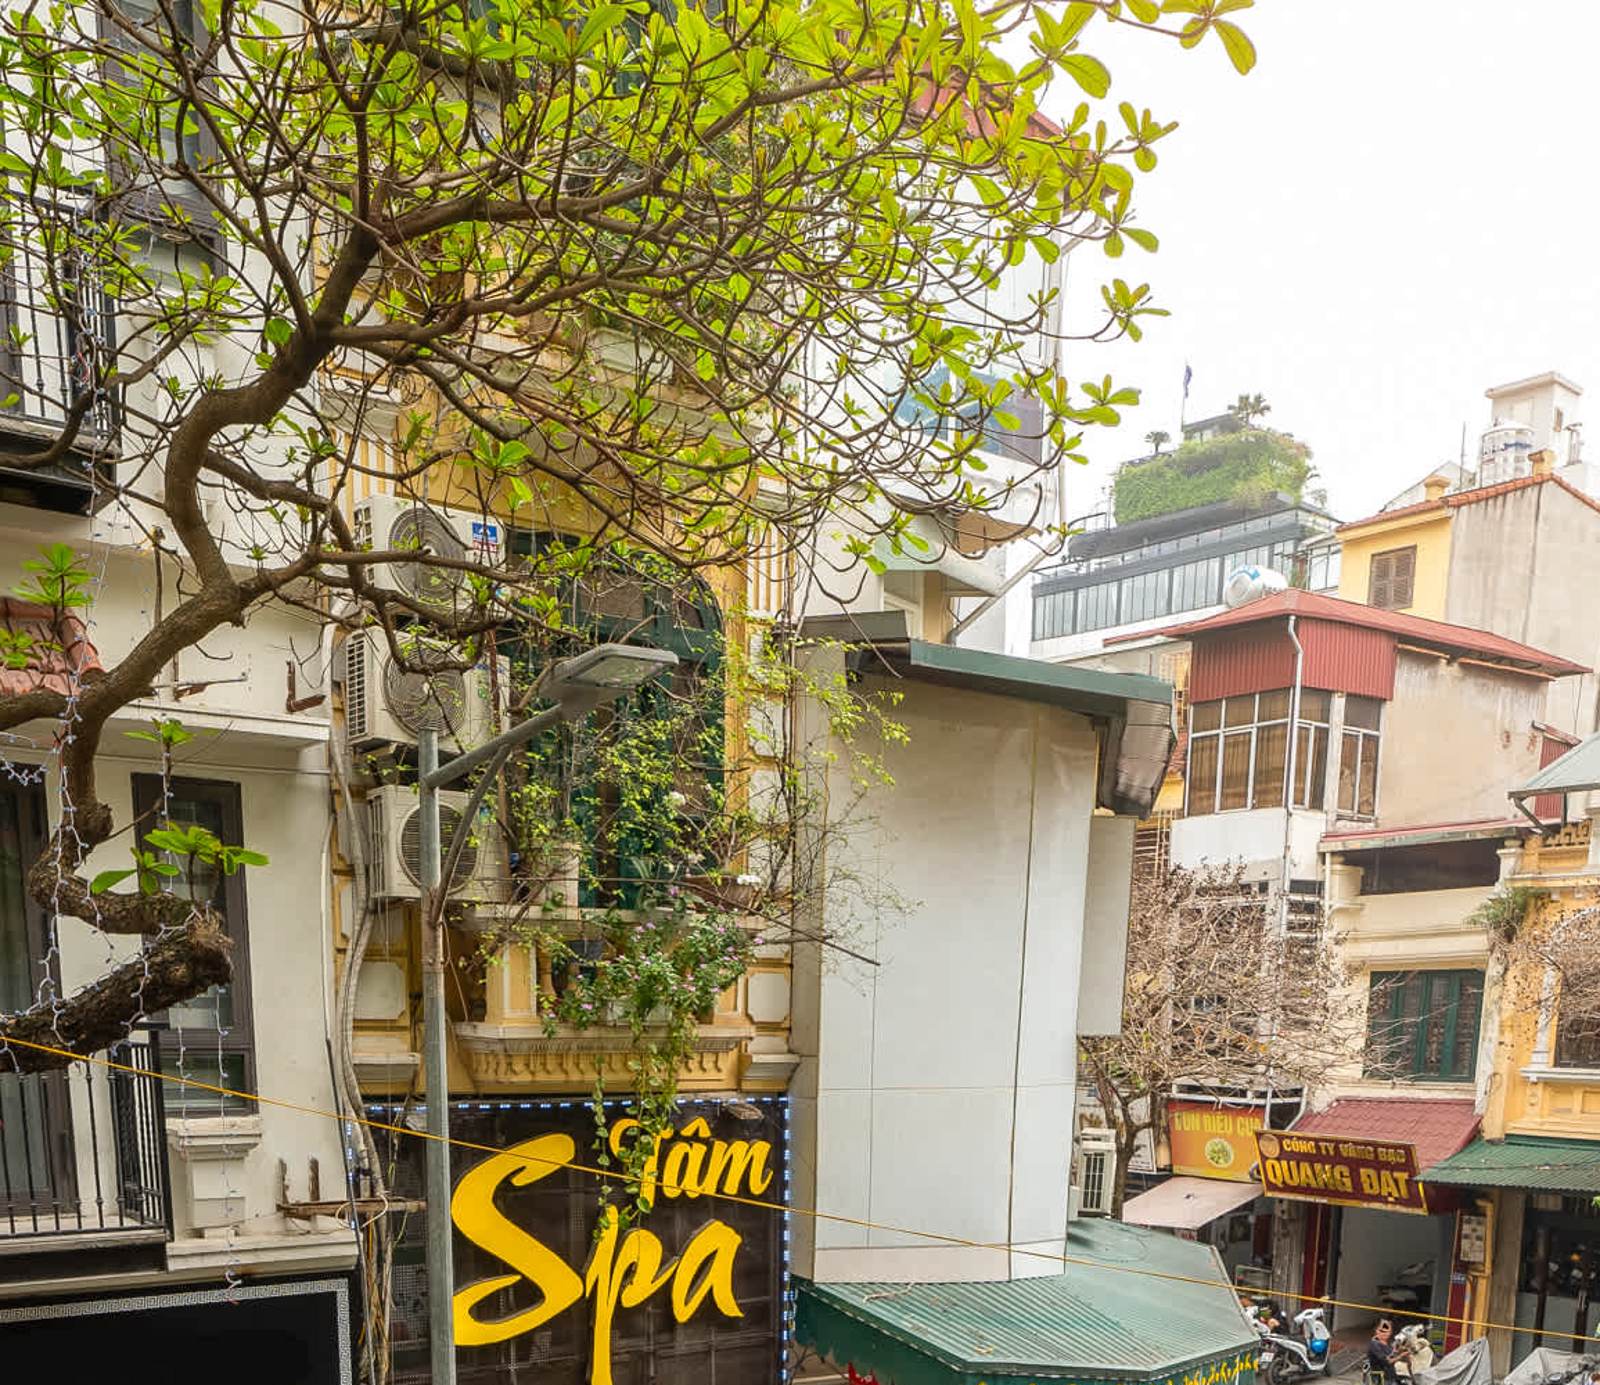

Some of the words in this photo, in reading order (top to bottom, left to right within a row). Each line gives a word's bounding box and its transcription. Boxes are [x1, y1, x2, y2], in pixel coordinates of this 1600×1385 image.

[609, 1116, 773, 1207] Tâm
[1318, 1142, 1336, 1156] TY
[1265, 1159, 1353, 1193] QUANG
